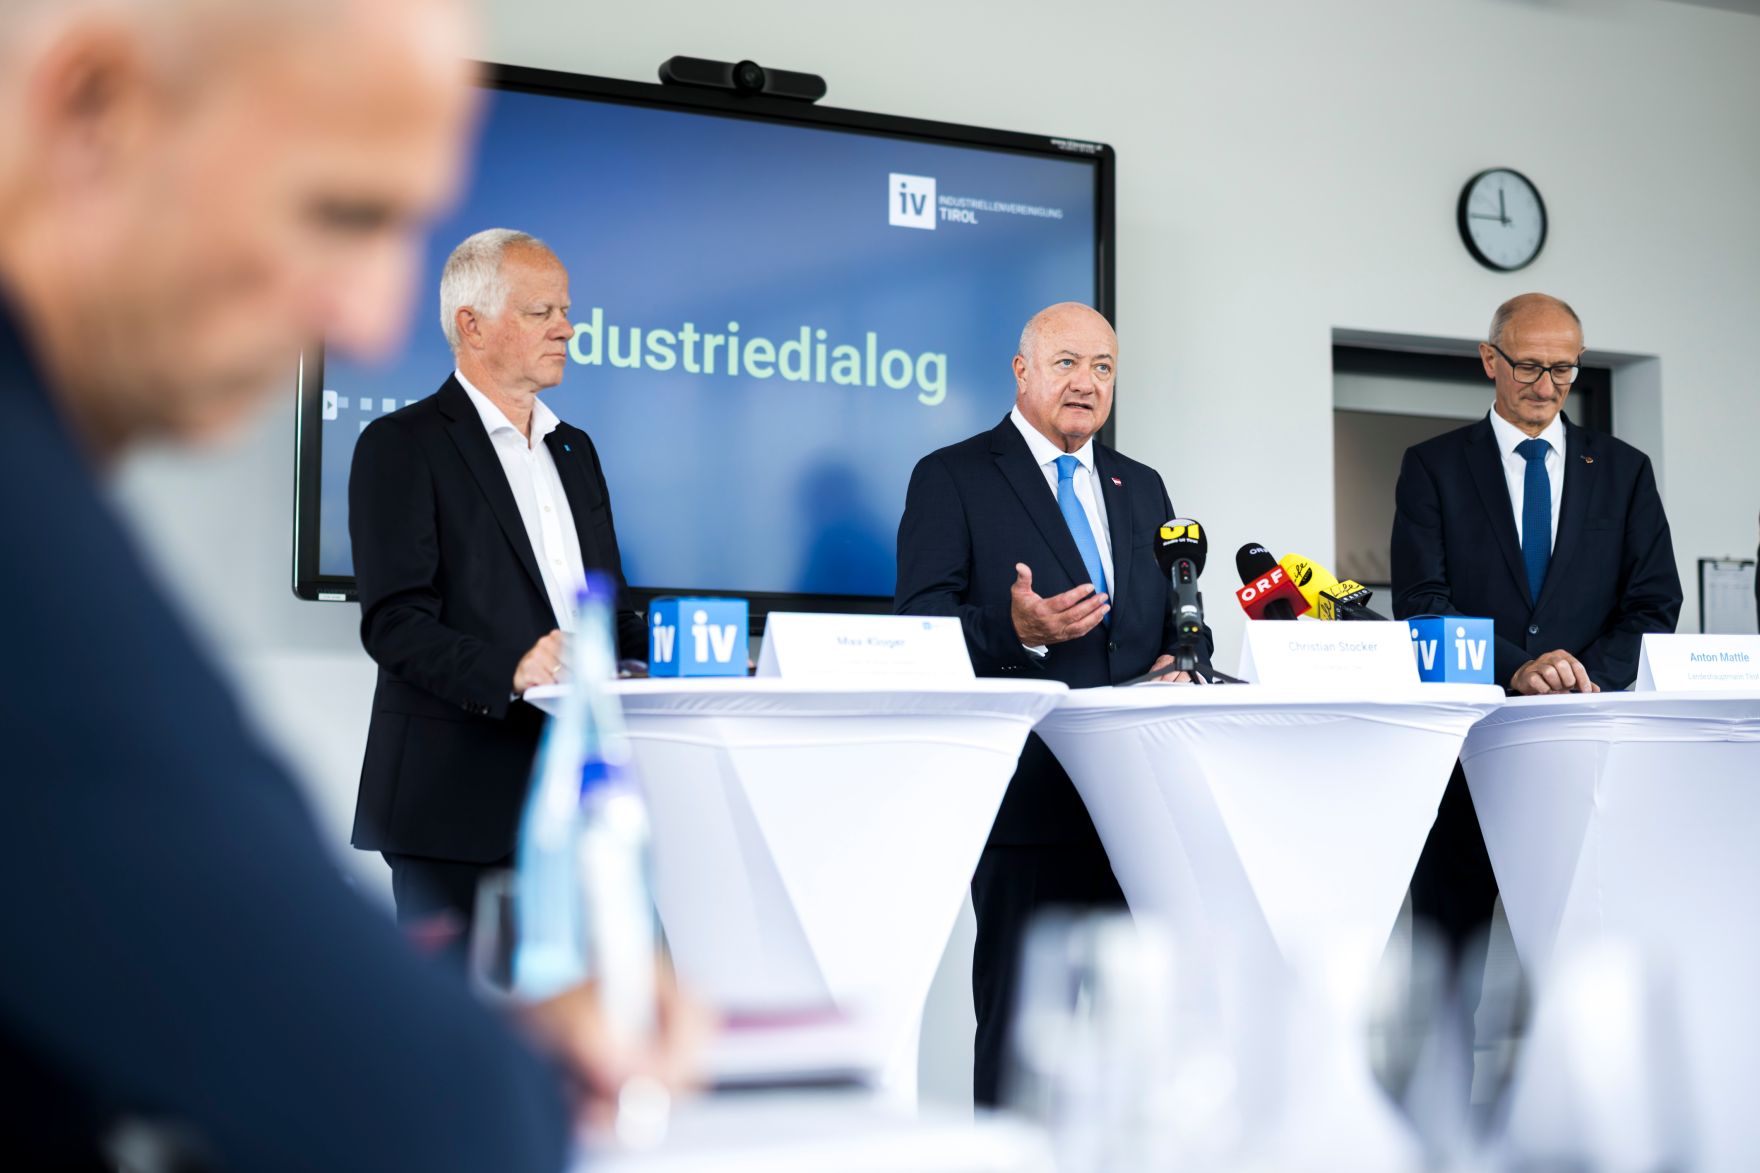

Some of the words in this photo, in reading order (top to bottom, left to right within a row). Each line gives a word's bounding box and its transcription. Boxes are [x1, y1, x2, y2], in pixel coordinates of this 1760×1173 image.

[899, 182, 927, 217] iv
[938, 195, 1064, 220] INDUSTRIELLENVEREINIGUNG
[939, 207, 979, 225] TIROL
[568, 307, 948, 407] dustriedialog
[1241, 568, 1283, 602] ORF
[1294, 562, 1308, 582] ife
[1343, 589, 1368, 603] RADIO
[653, 612, 675, 663] iv
[691, 609, 738, 664] iv
[1288, 641, 1336, 652] Christian
[1338, 641, 1378, 652] Stocker
[1455, 626, 1487, 671] iv
[1690, 652, 1718, 662] Anton
[1719, 652, 1750, 662] Mattle
